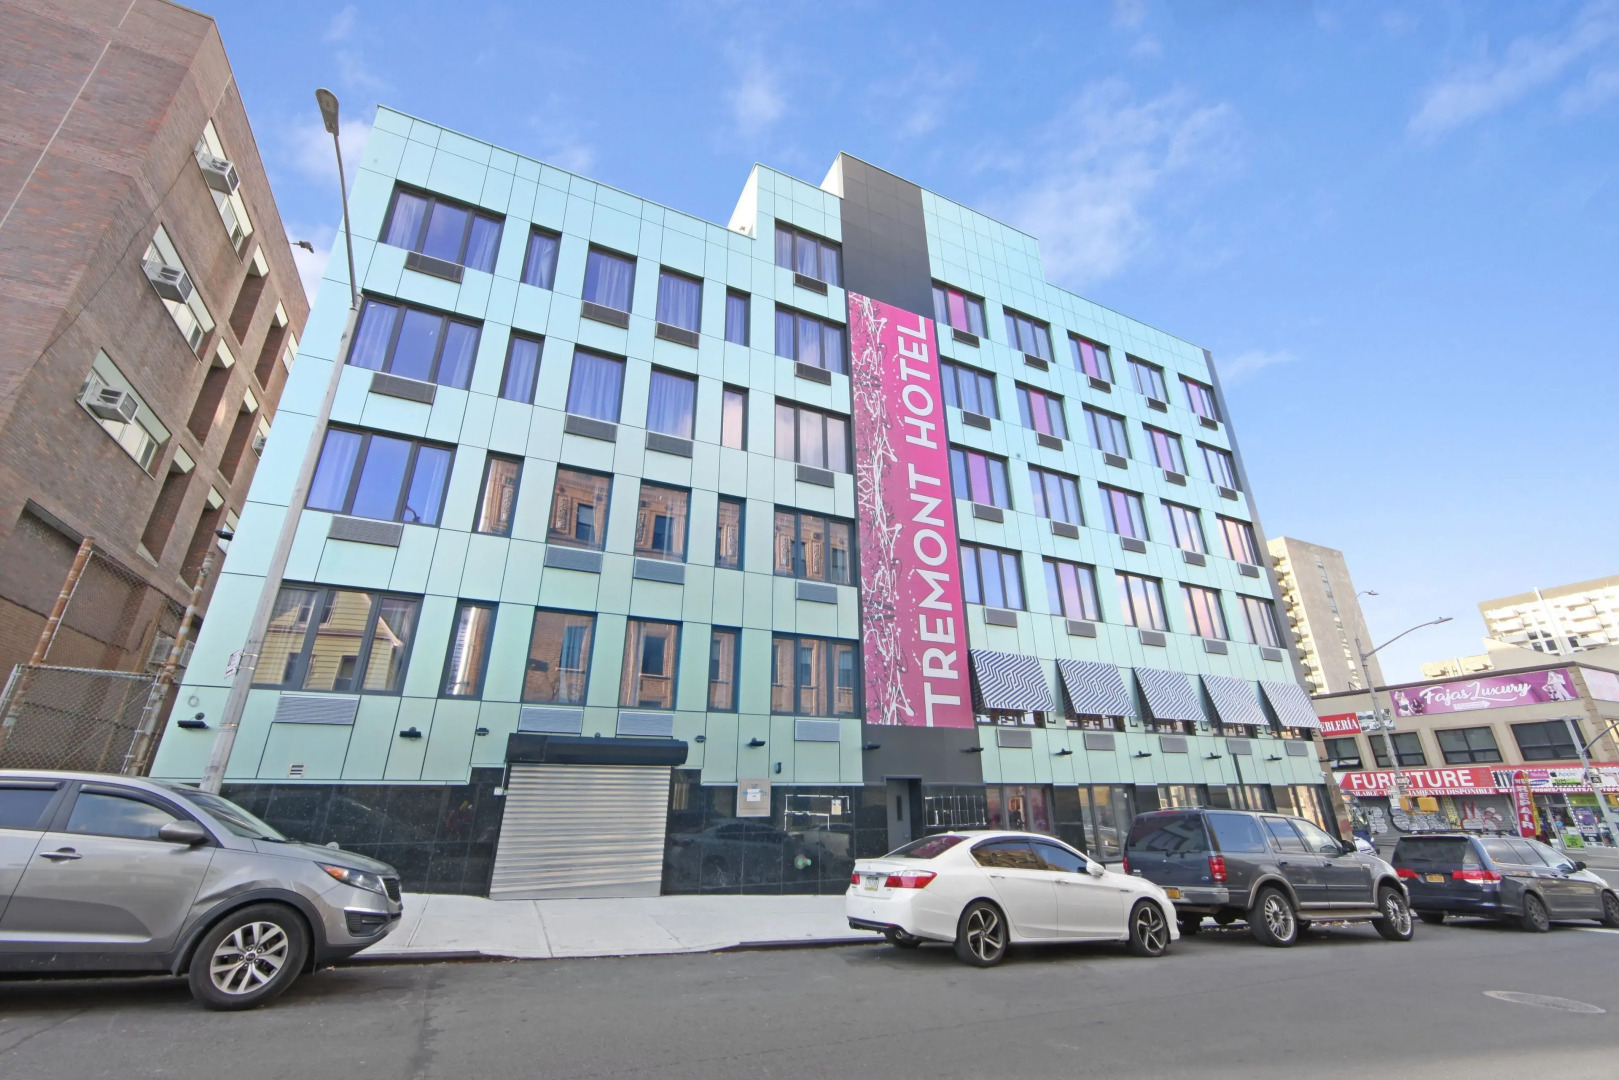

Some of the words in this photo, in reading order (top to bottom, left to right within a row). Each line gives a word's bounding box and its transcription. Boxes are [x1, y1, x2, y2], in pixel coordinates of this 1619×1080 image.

[896, 315, 938, 450] HOTEL
[908, 462, 961, 728] TREMONT
[1419, 684, 1471, 706] Fajas
[1466, 681, 1532, 701] Luxury
[1320, 716, 1359, 733] EBLERÍA
[1384, 788, 1445, 796] FIAMIENTO
[1446, 787, 1495, 796] DISPONIBLE
[1515, 785, 1535, 830] REPAIR
